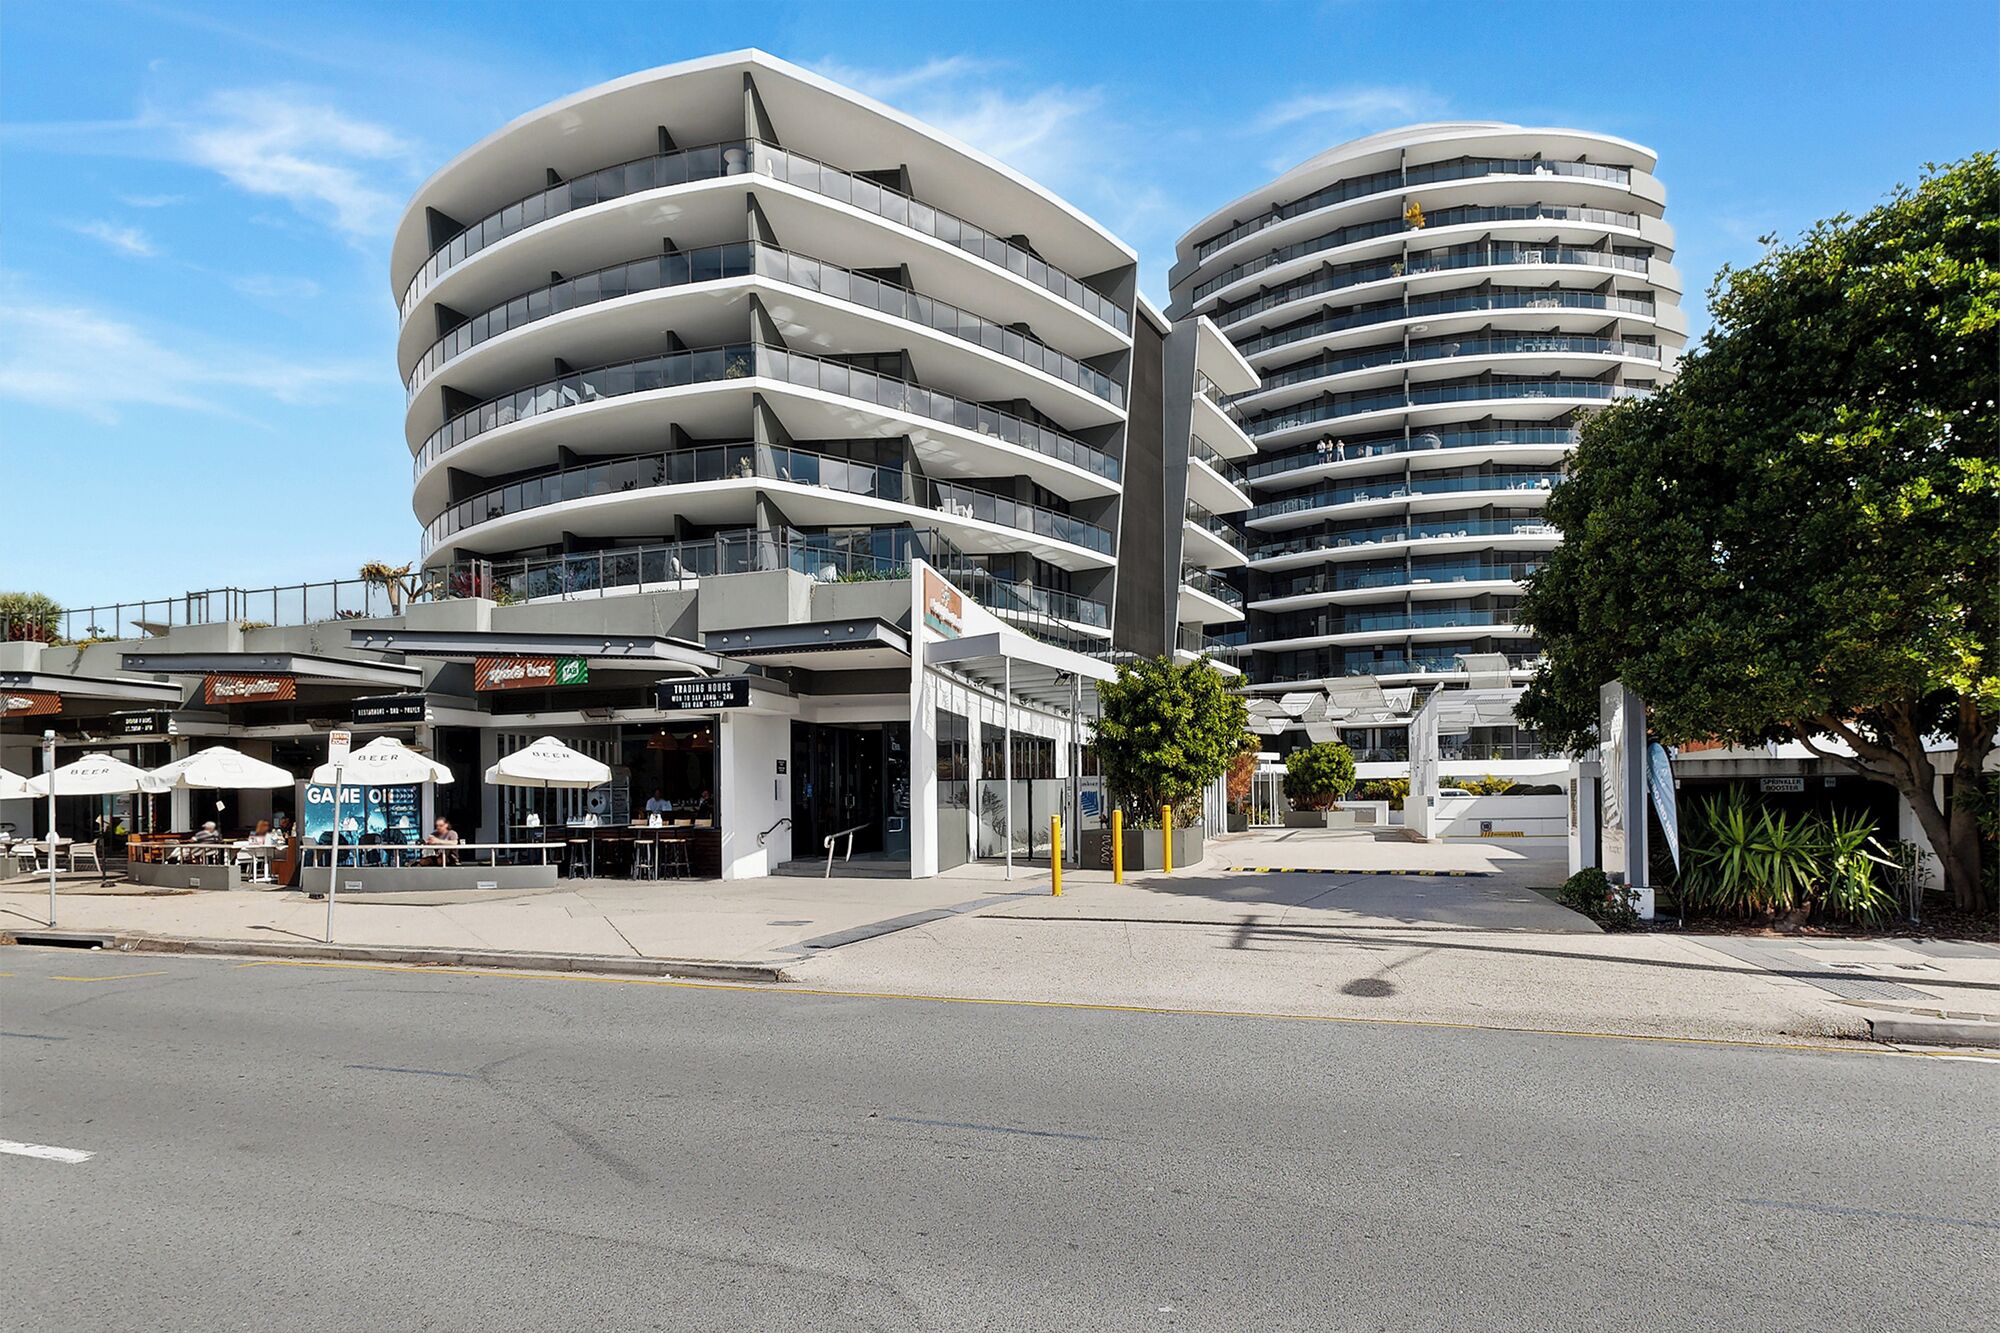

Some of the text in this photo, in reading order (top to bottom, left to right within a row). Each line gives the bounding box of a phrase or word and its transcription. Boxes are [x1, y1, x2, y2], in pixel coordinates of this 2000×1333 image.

[673, 682, 731, 694] TRADING HOURS
[532, 751, 569, 759] BEER
[307, 787, 360, 804] GAME
